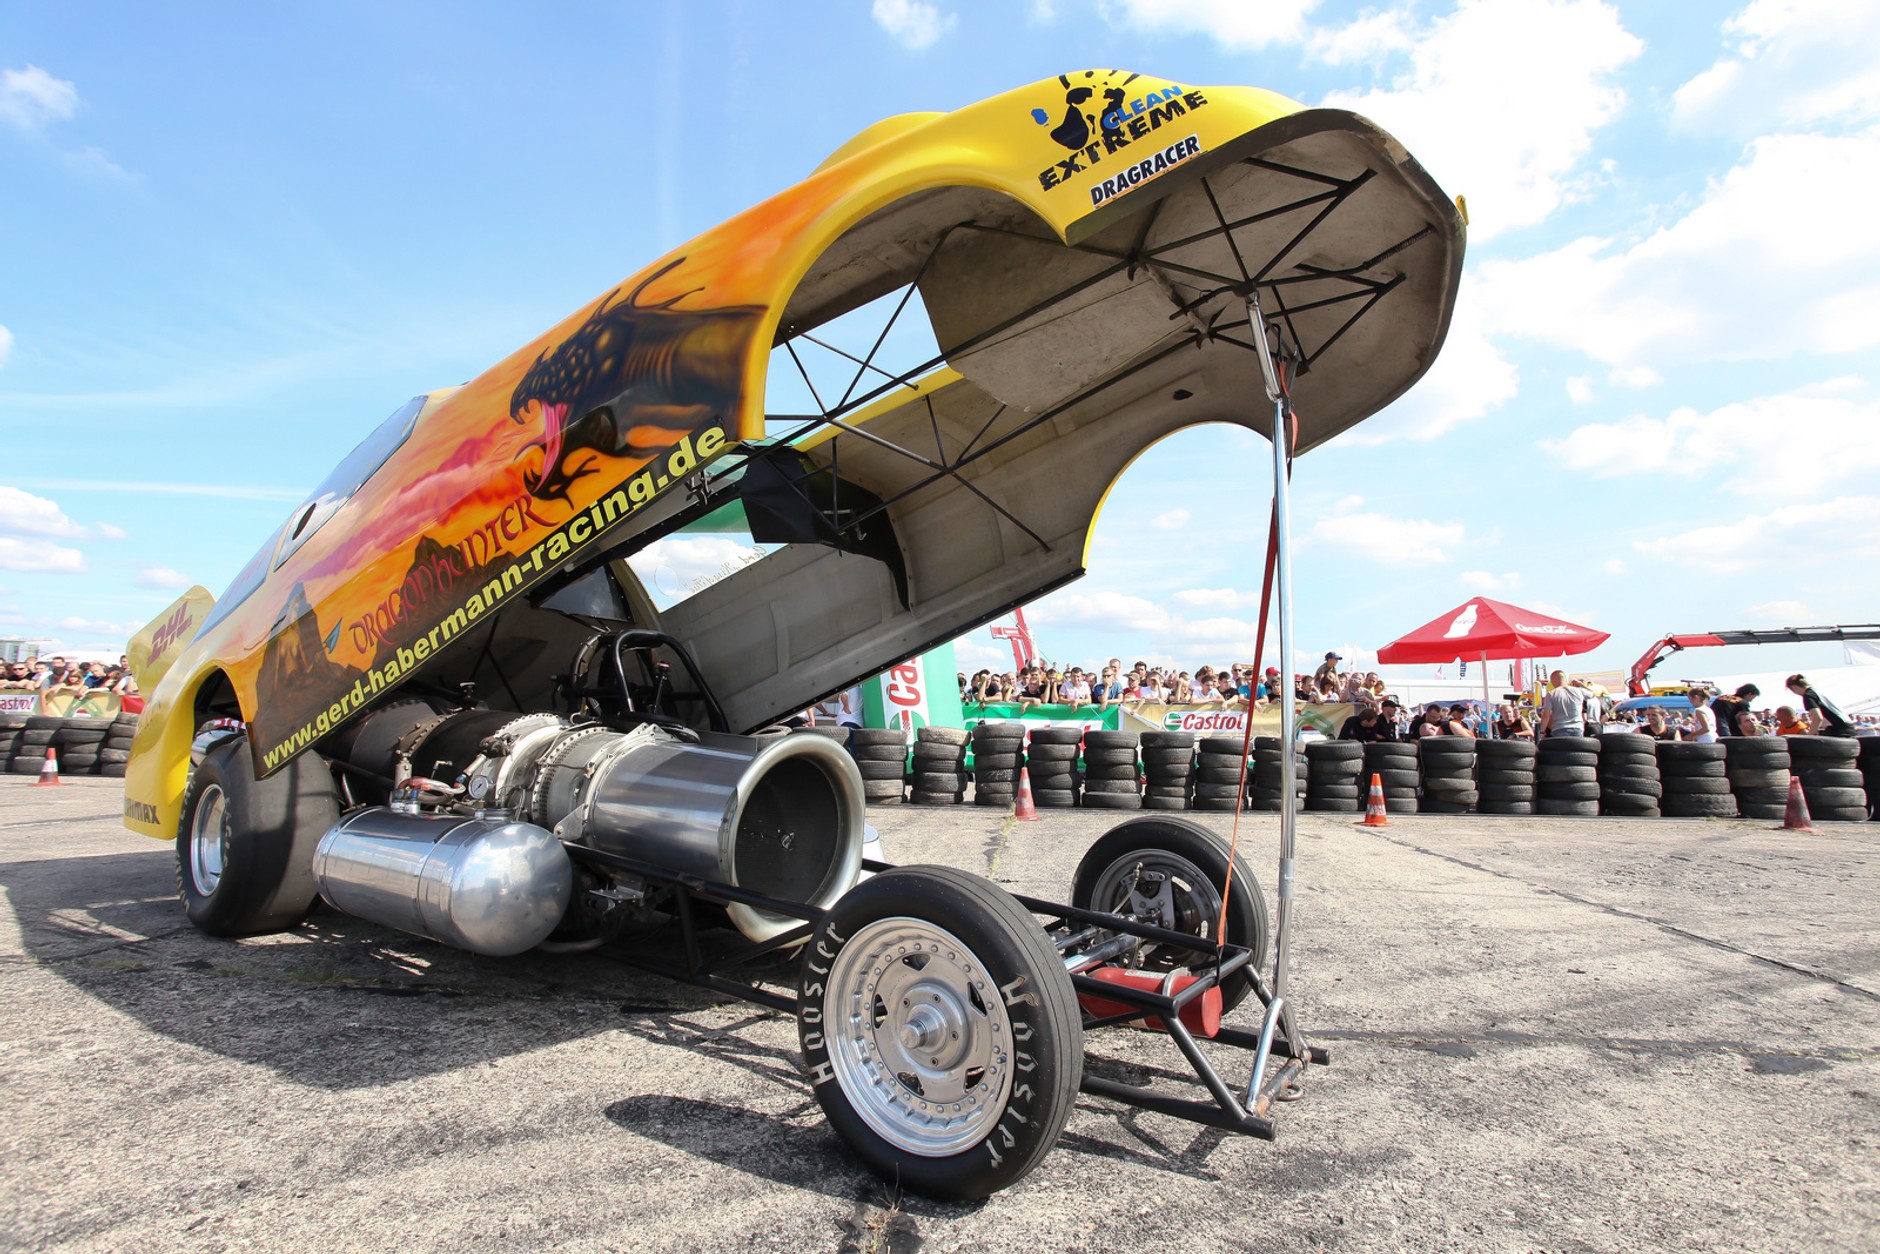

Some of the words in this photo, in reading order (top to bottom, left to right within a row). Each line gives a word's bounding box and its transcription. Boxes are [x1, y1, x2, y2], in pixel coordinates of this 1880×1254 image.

[1038, 90, 1208, 192] EXTREME
[1102, 85, 1184, 130] CLEAN
[1090, 135, 1200, 206] DRAGRACER
[262, 426, 726, 769] www.gerd-habermann-racing.de
[146, 600, 193, 669] DHL
[0, 696, 35, 710] astrol
[1183, 713, 1243, 731] Castrol
[802, 921, 845, 1088] Hoosier
[986, 975, 1040, 1169] Hoosier
